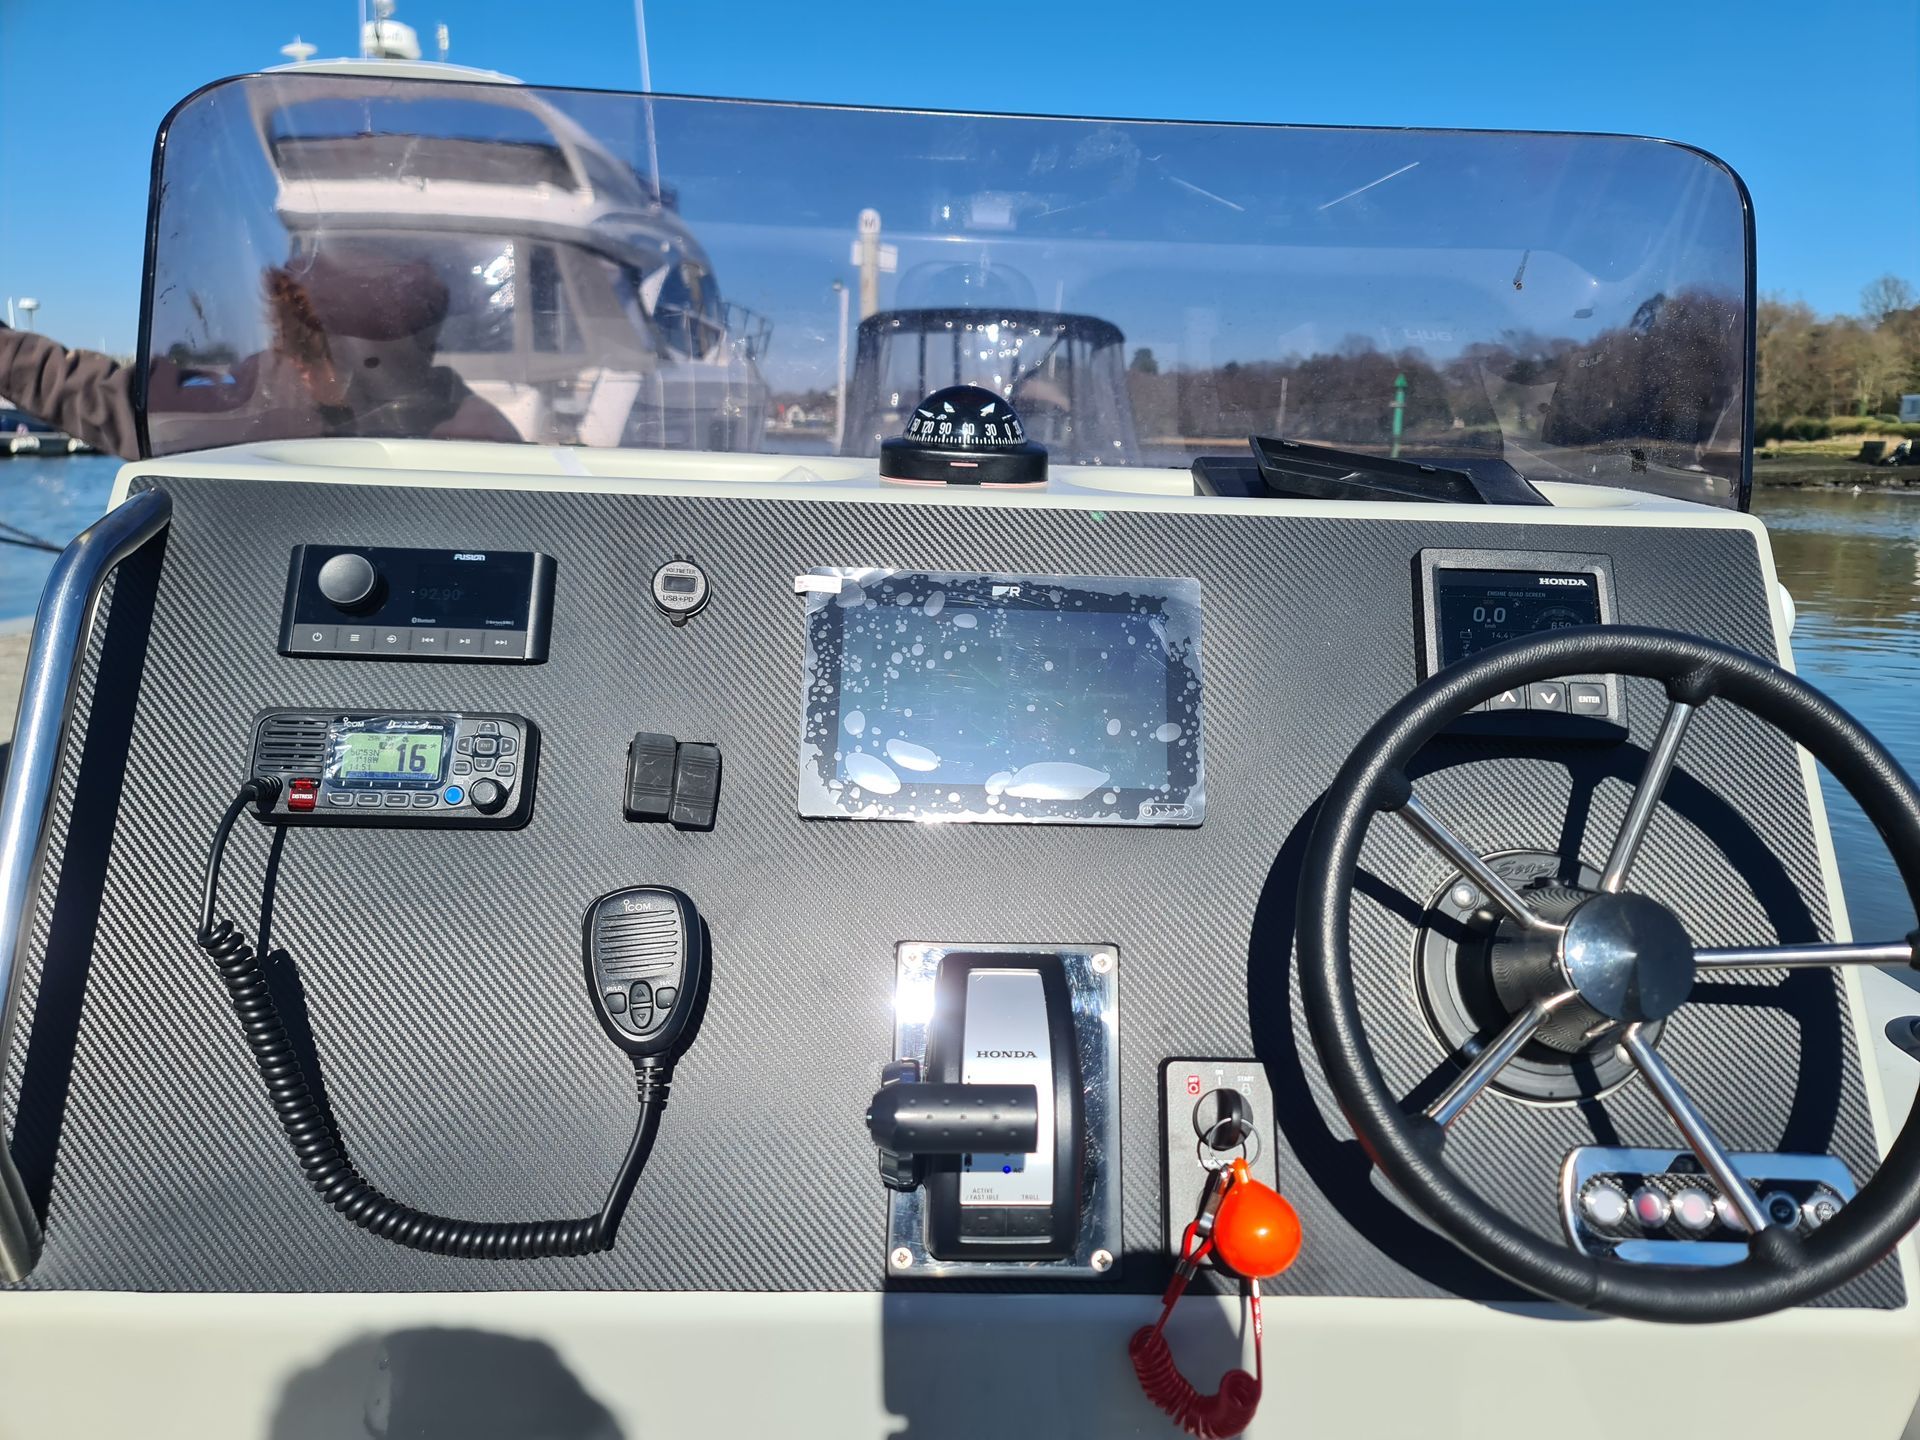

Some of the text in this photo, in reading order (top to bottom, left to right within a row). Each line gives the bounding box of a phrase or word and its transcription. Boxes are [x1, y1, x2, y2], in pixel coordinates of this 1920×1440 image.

[921, 420, 935, 434] 120
[938, 422, 952, 435] 90
[962, 421, 975, 436] 60
[985, 423, 997, 437] 30
[454, 553, 486, 562] FUSION
[1538, 577, 1588, 587] HONDA
[1486, 590, 1506, 598] ENGINE
[1473, 606, 1506, 623] 0.0
[1578, 695, 1600, 704] ENTER
[397, 743, 426, 772] 16
[976, 1050, 1038, 1059] HONDA
